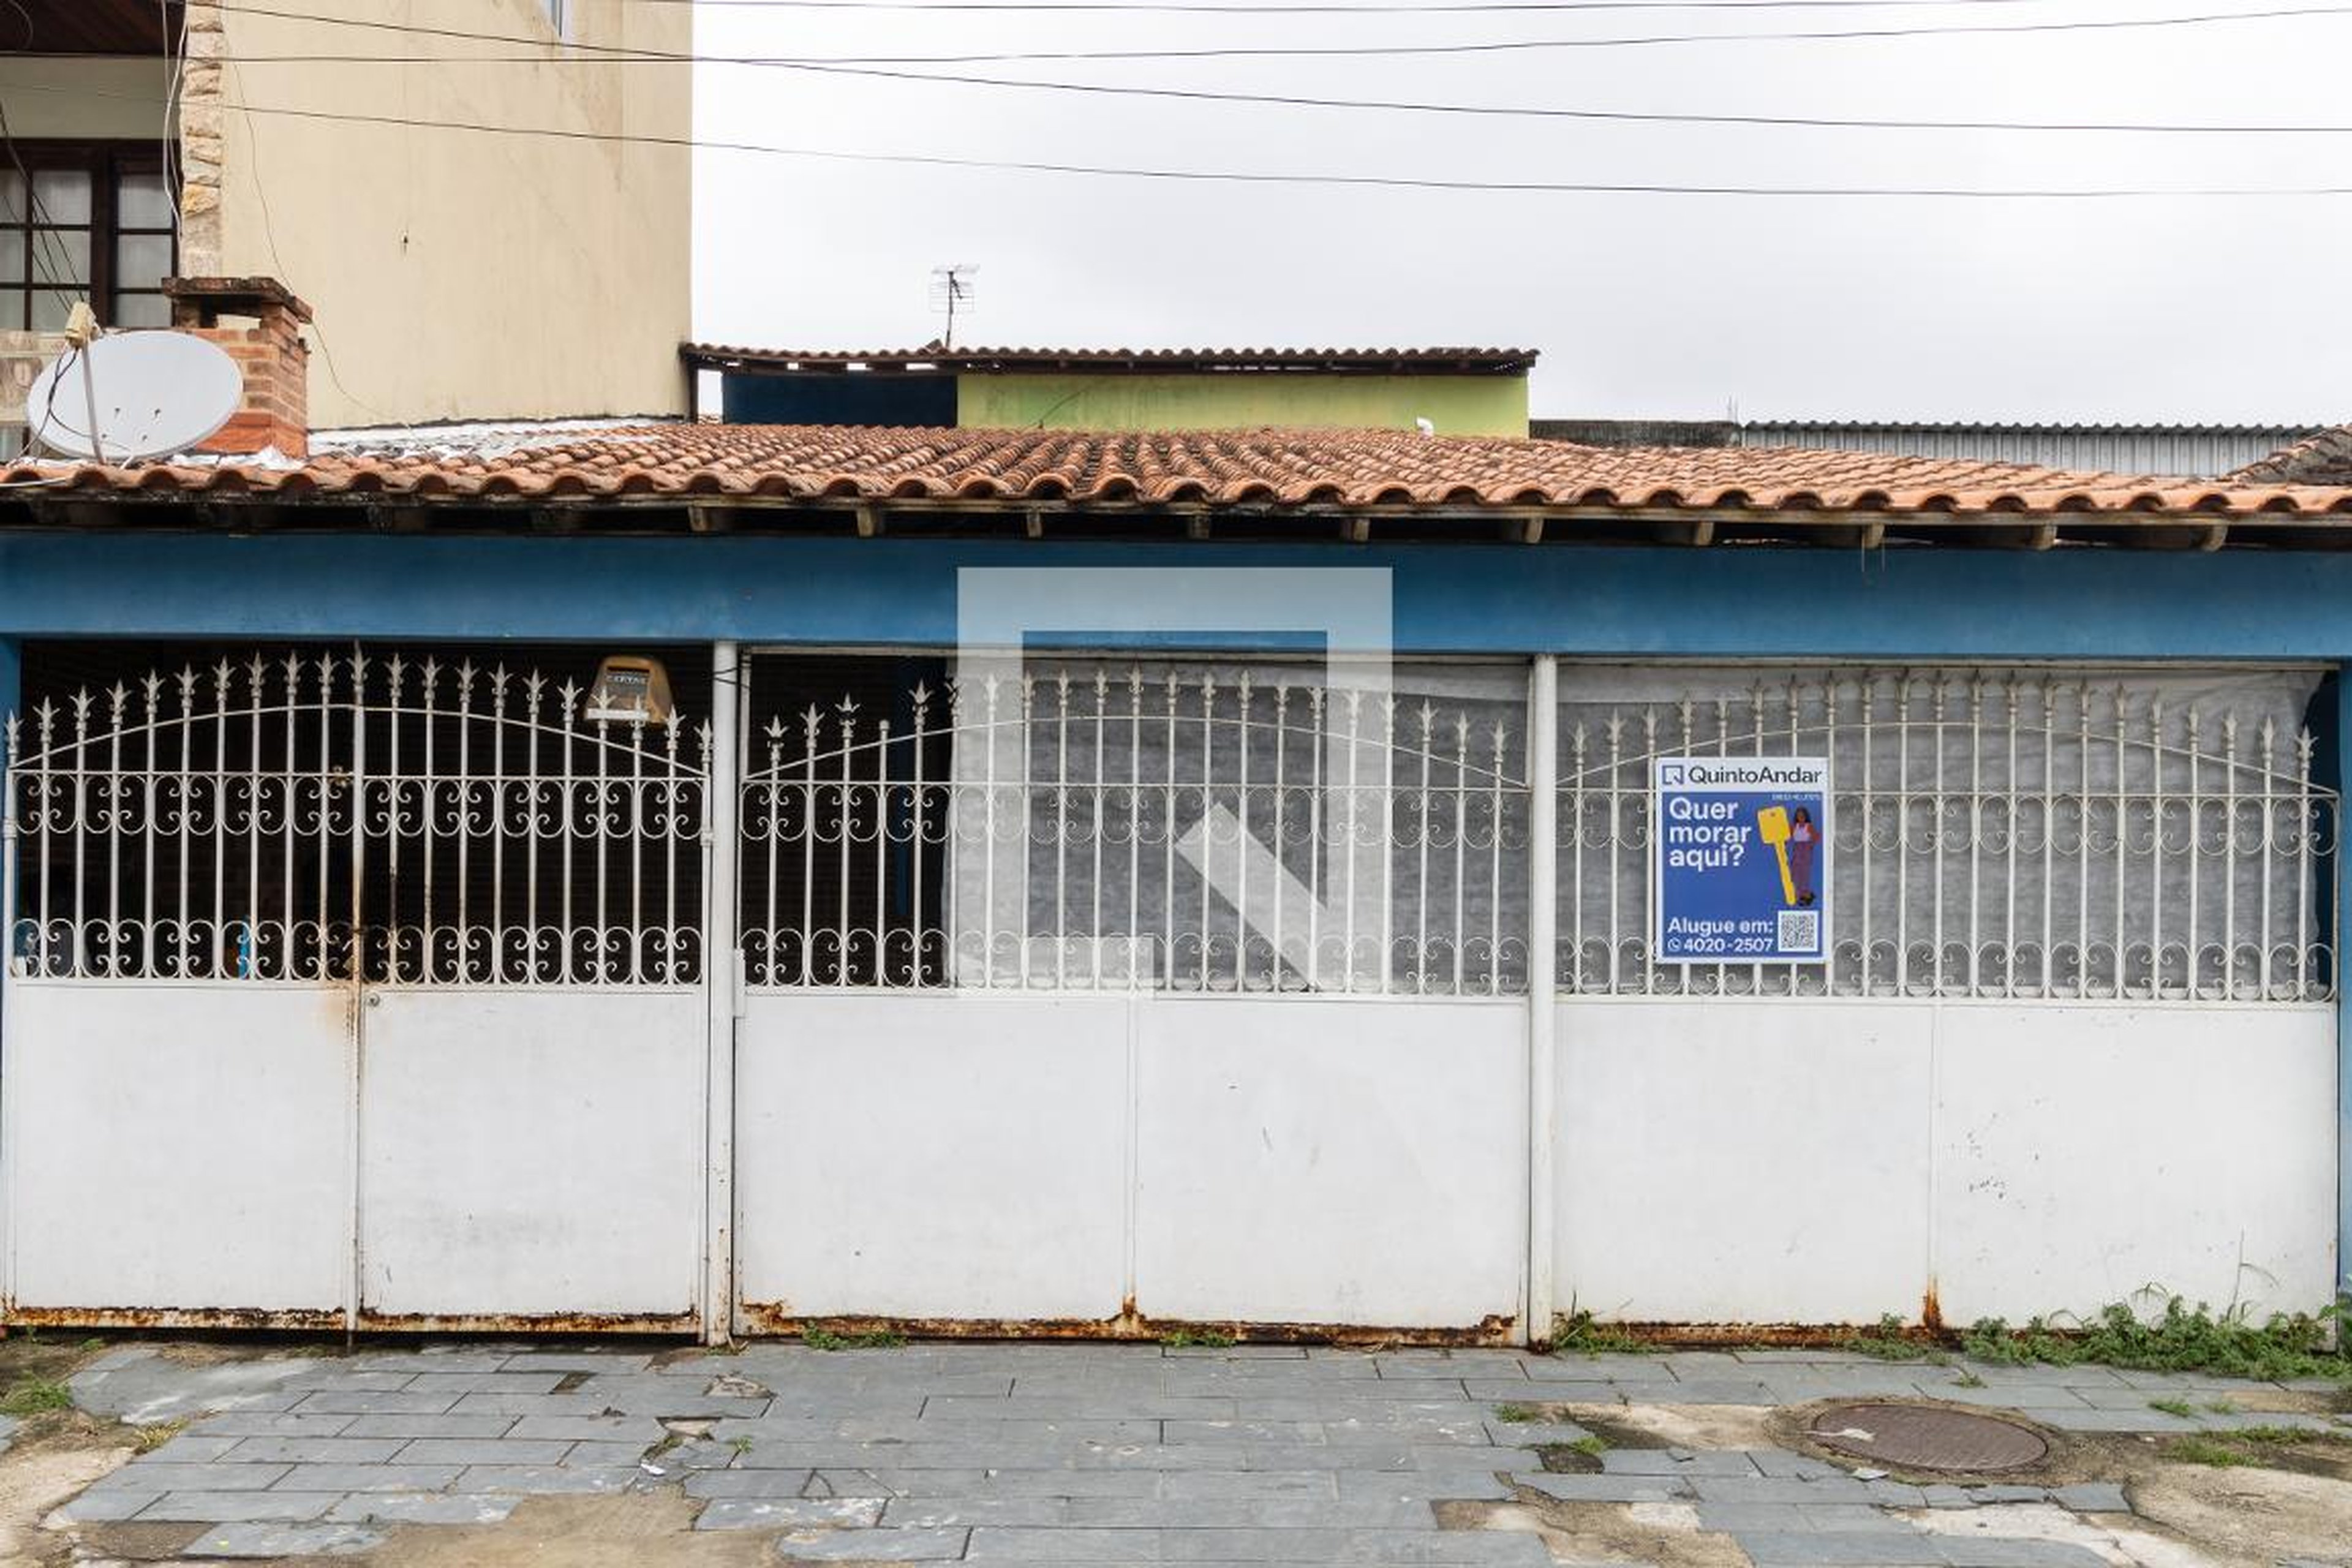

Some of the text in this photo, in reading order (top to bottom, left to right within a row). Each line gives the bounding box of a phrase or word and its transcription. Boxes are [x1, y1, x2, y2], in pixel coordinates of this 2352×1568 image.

[1688, 766, 1822, 784] QuintoAndar
[1668, 797, 1738, 820] Quer
[1669, 826, 1752, 843] morar
[1669, 844, 1744, 873] aqui?
[1667, 917, 1774, 937] Alugue em:
[1684, 938, 1774, 952] 4020-2507
